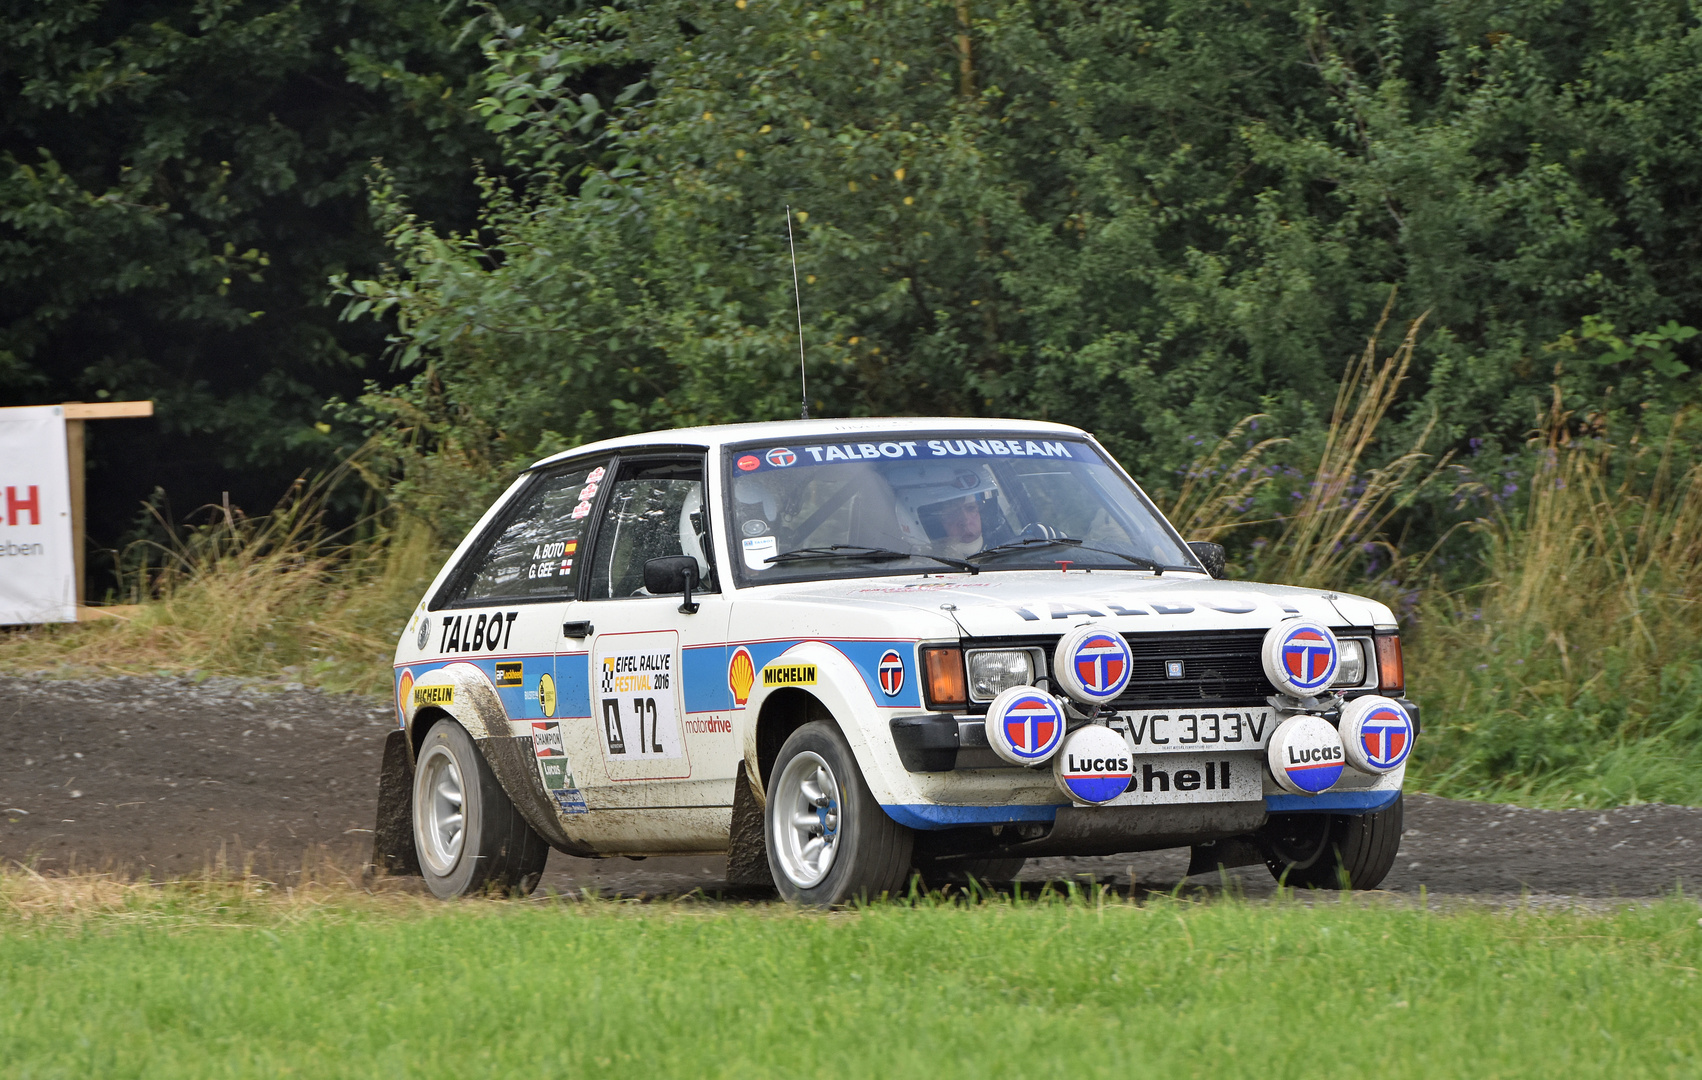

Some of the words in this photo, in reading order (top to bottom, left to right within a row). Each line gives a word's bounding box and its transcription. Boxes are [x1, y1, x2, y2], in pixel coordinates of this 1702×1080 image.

[804, 441, 918, 462] TALBOT
[930, 439, 1073, 459] SUNBEAM
[0, 484, 41, 526] H
[532, 544, 541, 560] A.
[542, 541, 565, 559] BOTO
[528, 563, 537, 579] G.
[537, 561, 555, 578] GEE
[440, 611, 518, 653] TALBOT
[615, 655, 637, 673] EIFEL
[639, 653, 671, 671] RALLYE
[614, 674, 652, 692] FESTIVAL
[653, 673, 670, 690] 2016
[764, 665, 815, 684] MICHELIN
[414, 687, 453, 703] MICHELIN
[633, 697, 664, 754] 72
[1178, 712, 1268, 744] 333V
[535, 733, 561, 746] CHAMPION
[1068, 753, 1129, 773] Lucas
[1288, 744, 1343, 766] Lucas
